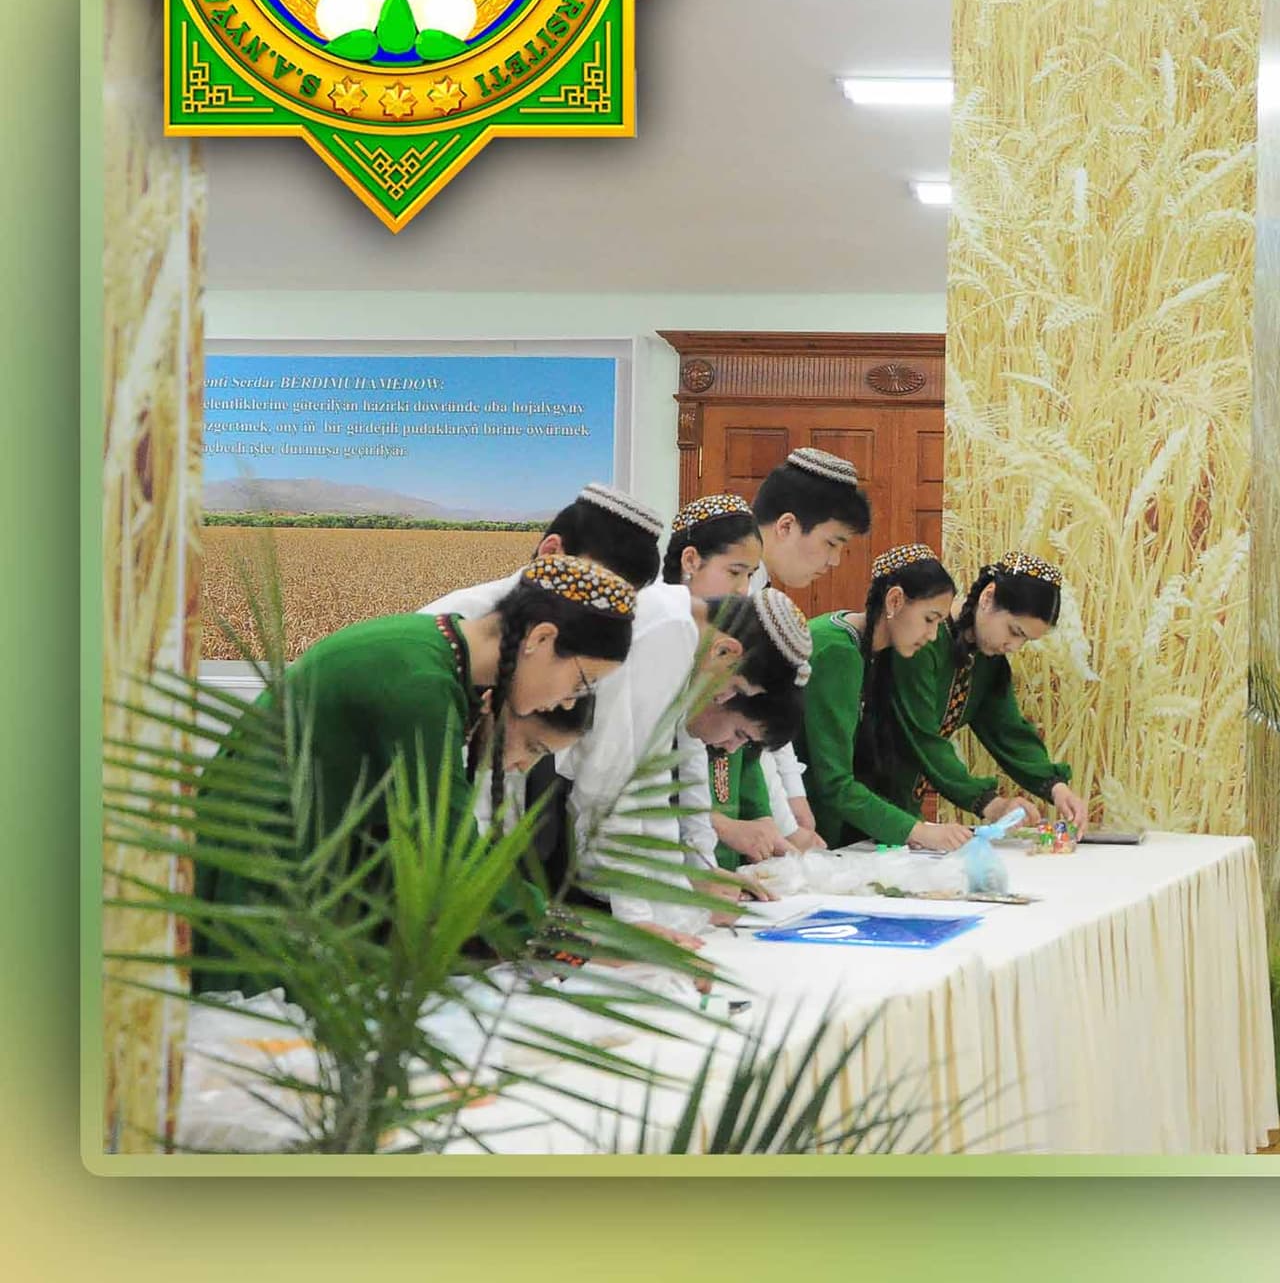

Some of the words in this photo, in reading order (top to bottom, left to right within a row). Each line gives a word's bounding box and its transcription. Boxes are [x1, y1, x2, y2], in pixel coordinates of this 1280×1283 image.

[203, 376, 226, 390] enti
[232, 376, 276, 390] Serdar
[203, 396, 289, 411] elentliklerine
[484, 401, 507, 413] oba
[203, 420, 271, 435] zgertmek,
[324, 421, 342, 434] bir
[483, 424, 523, 436] birine
